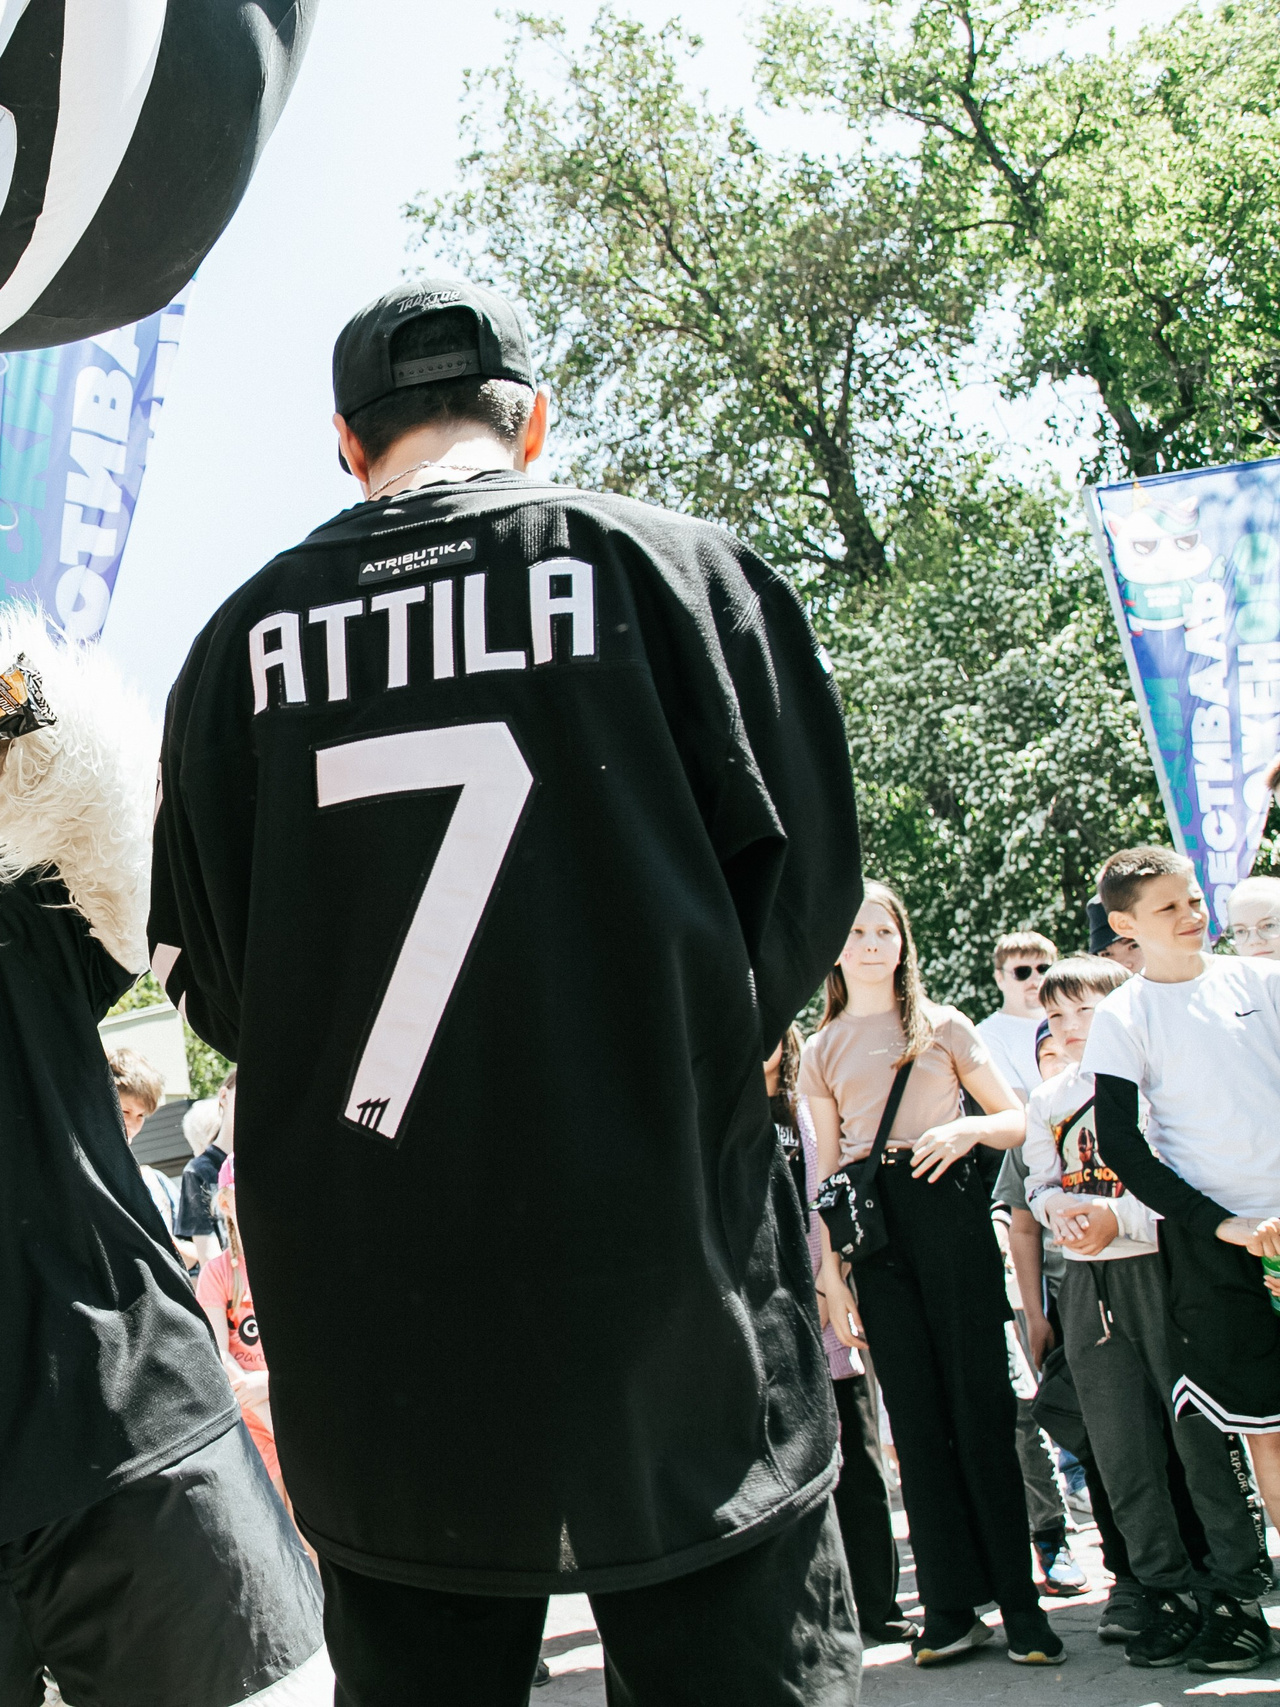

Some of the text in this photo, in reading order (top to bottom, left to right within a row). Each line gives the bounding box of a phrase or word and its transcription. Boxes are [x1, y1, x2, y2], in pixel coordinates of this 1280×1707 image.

[362, 540, 472, 574] ATRIBUTIKA
[404, 558, 439, 572] CLUB
[248, 557, 595, 716] ATTILA
[316, 721, 534, 1139] 7
[1230, 1450, 1249, 1493] EXPLORE
